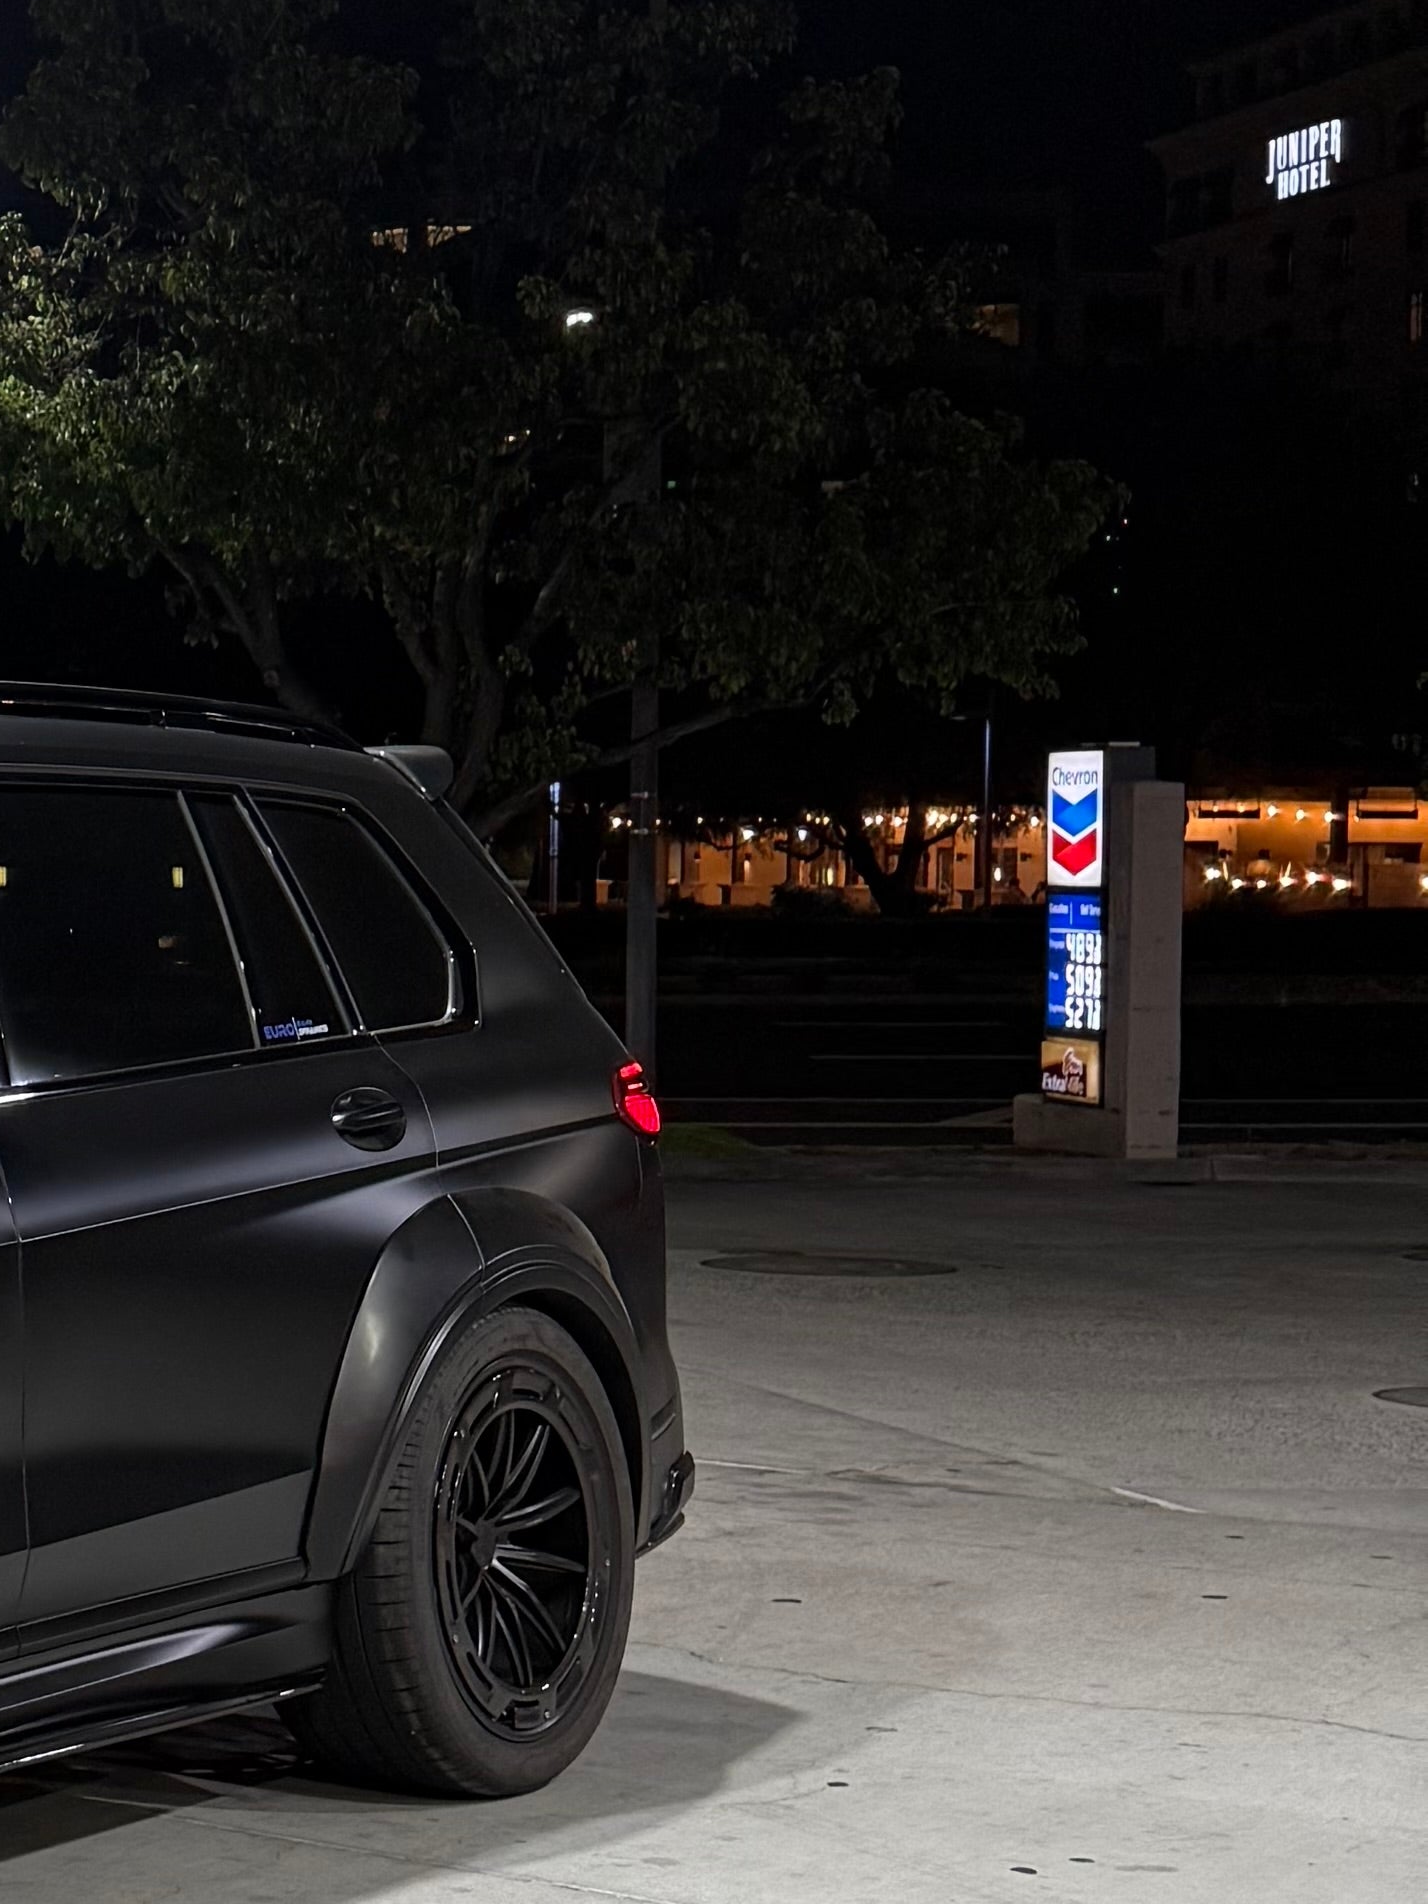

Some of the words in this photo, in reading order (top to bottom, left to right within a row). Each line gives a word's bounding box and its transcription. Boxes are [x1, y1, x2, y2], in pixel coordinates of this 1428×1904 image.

[1265, 118, 1342, 184] JUNIPER
[1277, 158, 1331, 200] HOTEL
[1051, 765, 1098, 787] Chevron
[263, 1022, 295, 1039] EURO
